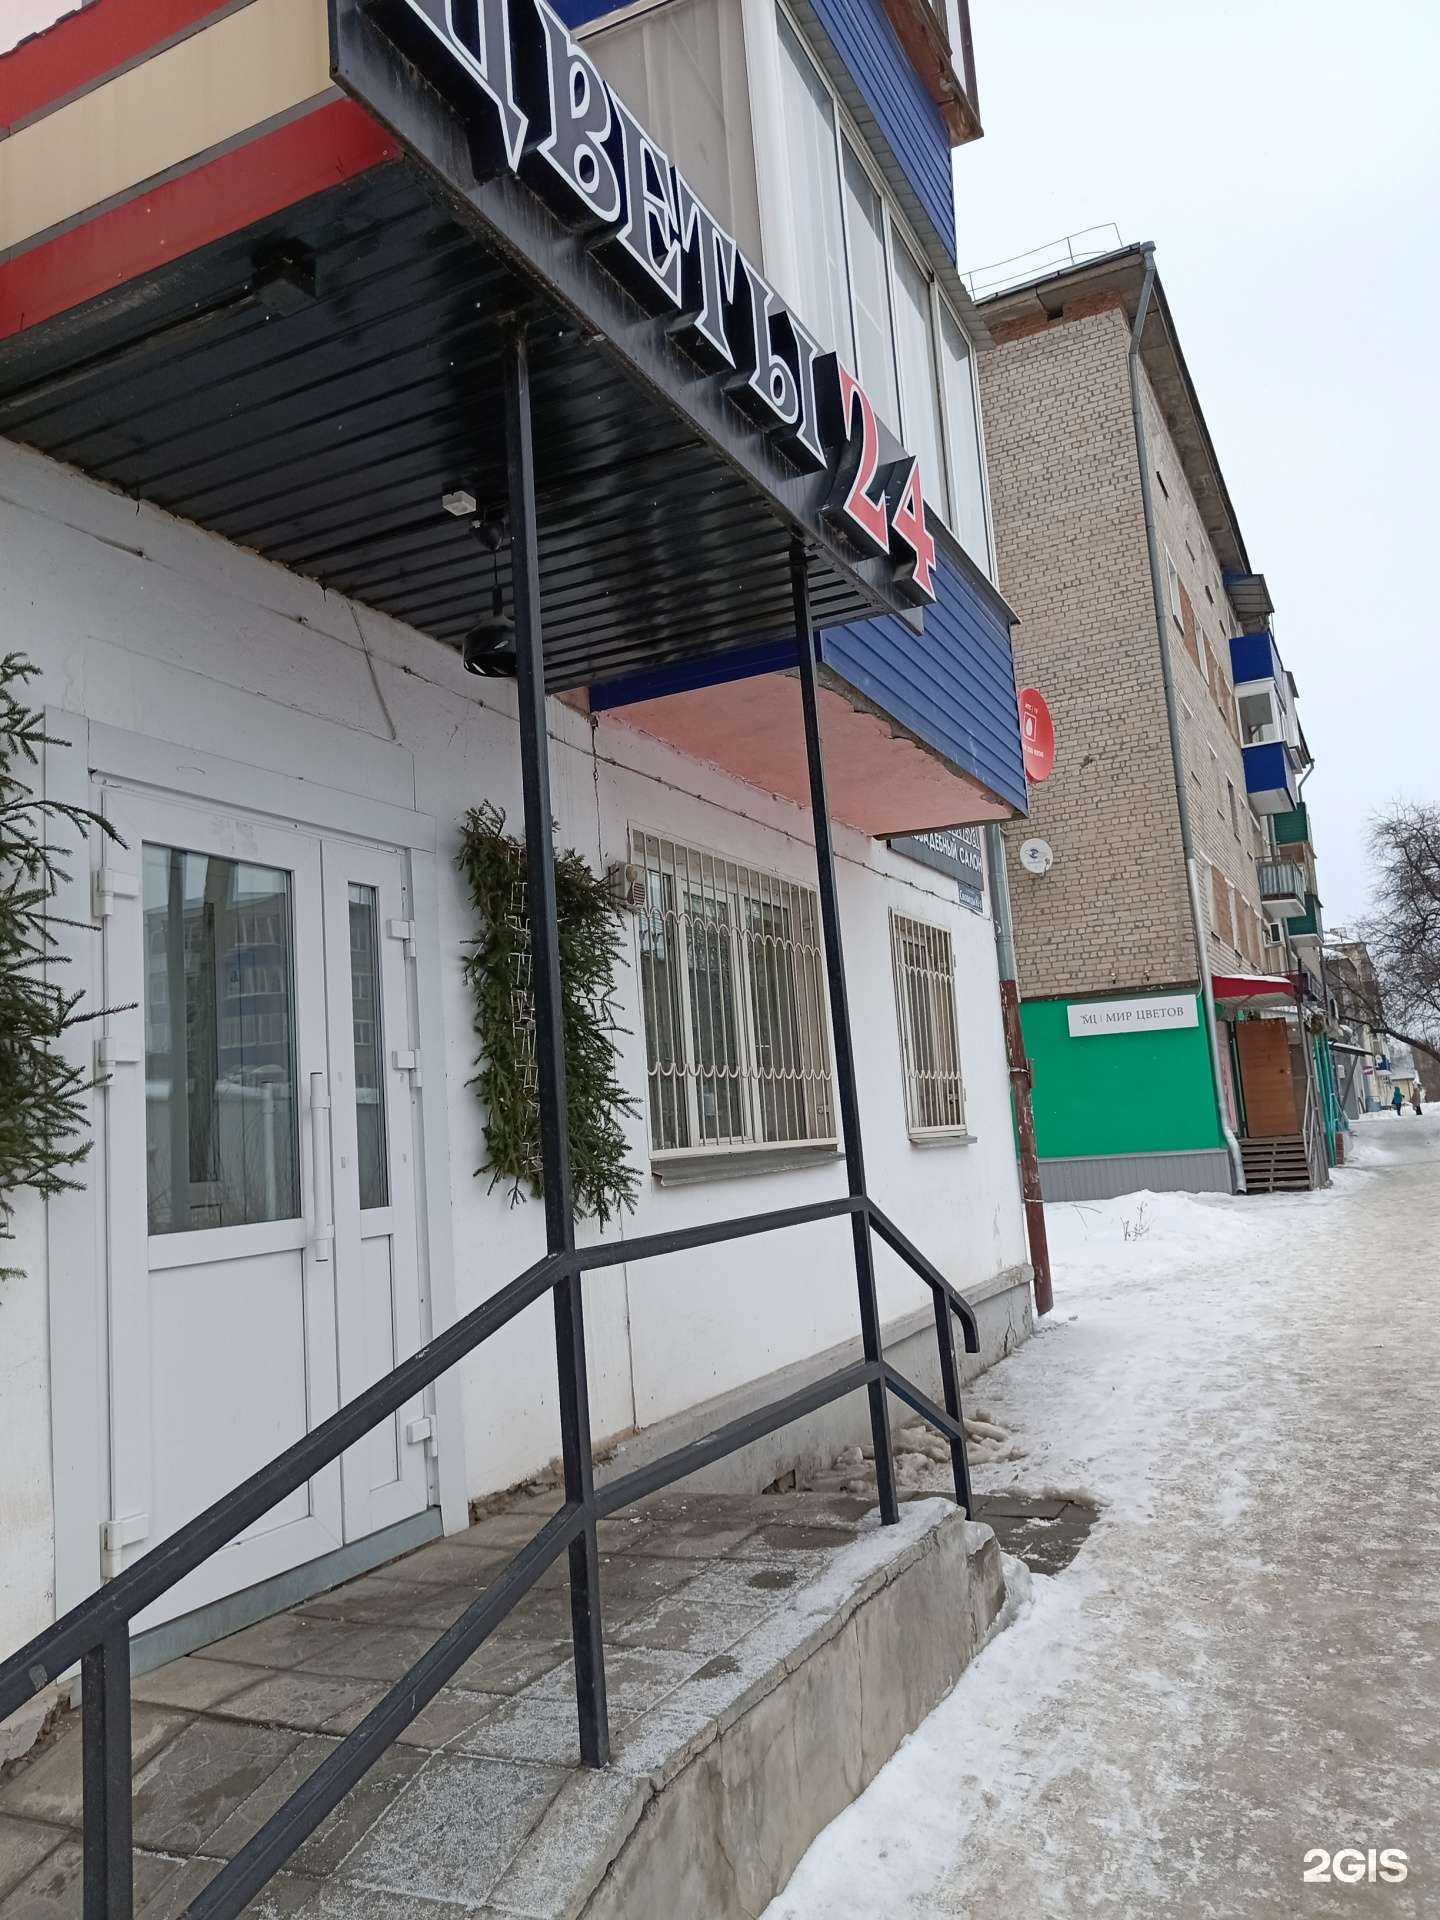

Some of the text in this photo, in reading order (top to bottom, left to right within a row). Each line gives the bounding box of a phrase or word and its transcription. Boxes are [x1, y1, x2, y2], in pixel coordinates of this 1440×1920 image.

[837, 357, 937, 602] 24
[912, 832, 958, 861] АДЕБНЫЙ
[1105, 1010, 1132, 1023] МИР
[1136, 1006, 1184, 1021] ЦВЕТОВ
